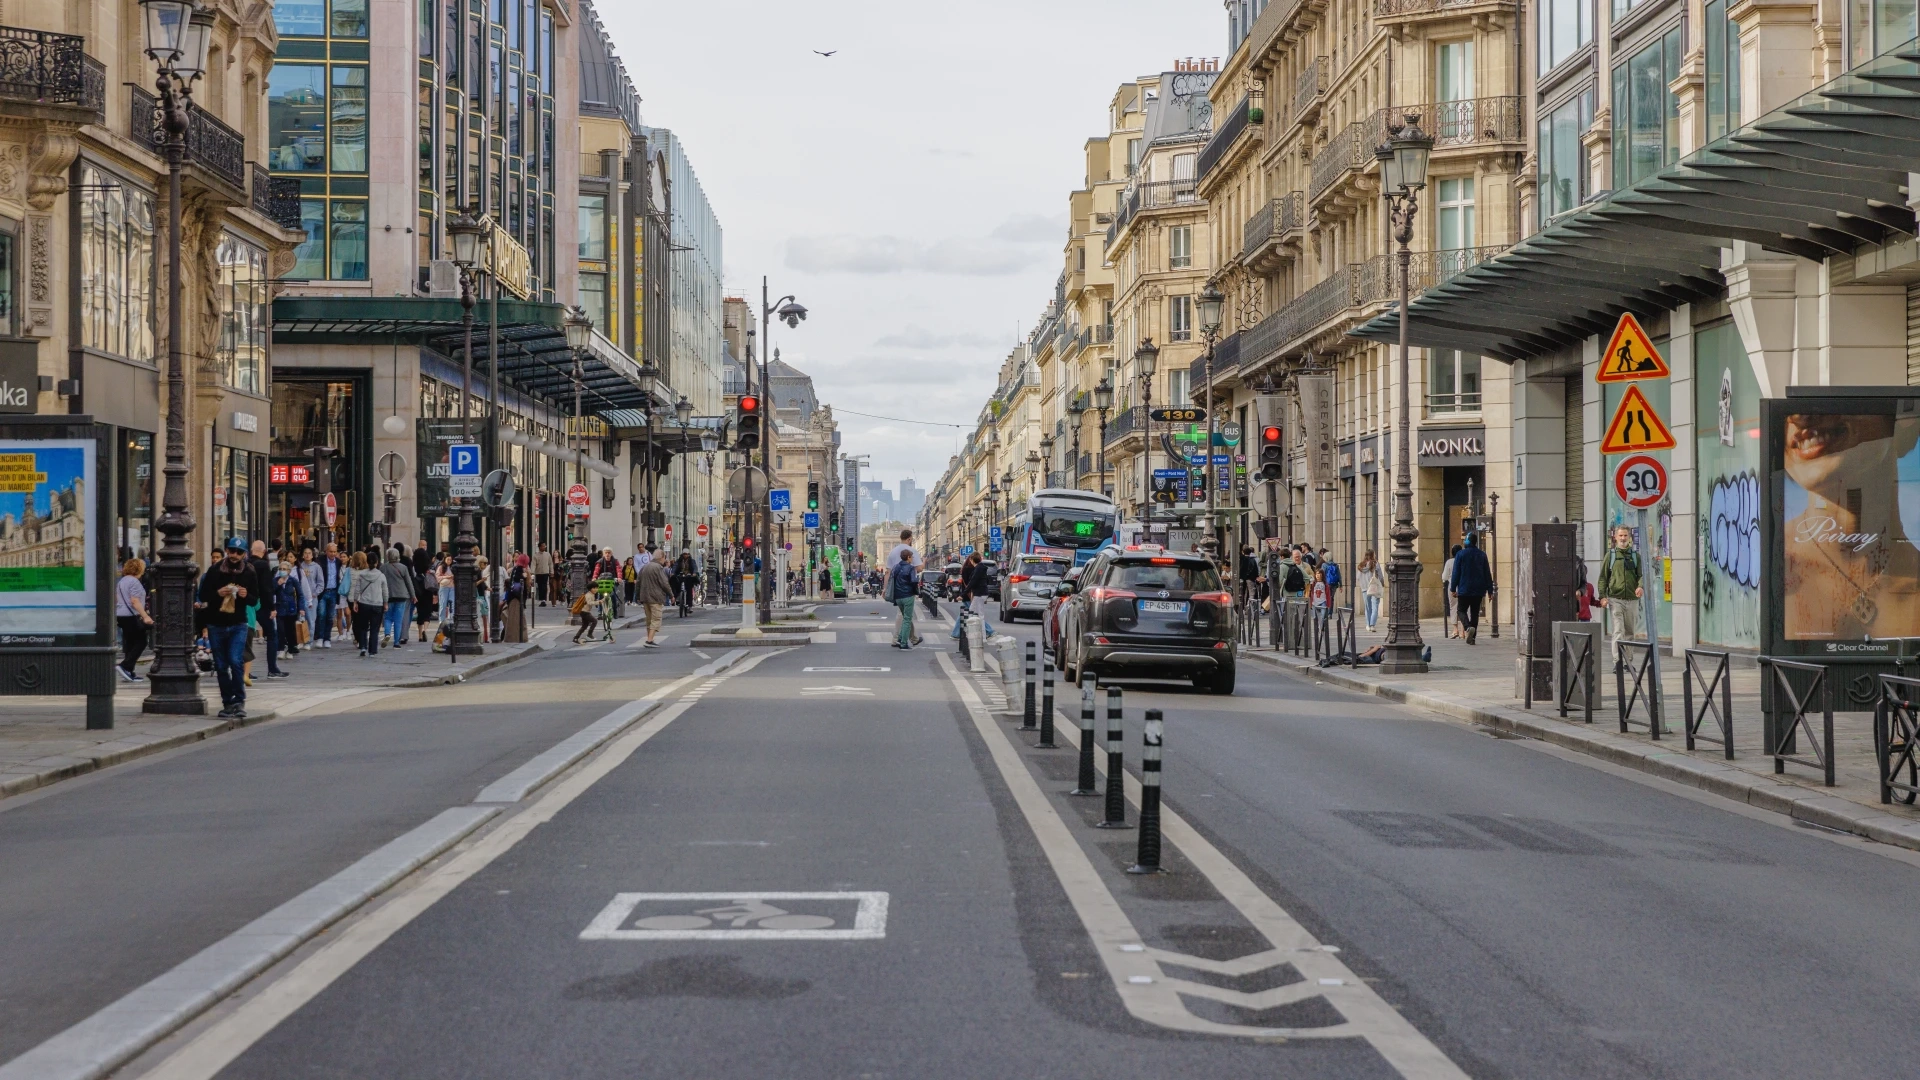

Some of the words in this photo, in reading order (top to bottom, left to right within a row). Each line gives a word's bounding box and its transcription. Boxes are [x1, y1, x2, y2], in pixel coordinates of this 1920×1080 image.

[1224, 427, 1239, 436] BUS
[1183, 445, 1196, 453] BUS
[1418, 437, 1483, 455] MONKI
[0, 455, 34, 463] NCONTRER
[458, 451, 472, 470] P
[28, 473, 45, 481] BILAN
[1626, 470, 1658, 492] 30
[1169, 532, 1204, 540] RIMO
[1794, 516, 1879, 552] Poiray
[1837, 644, 1858, 652] Clear
[1858, 644, 1889, 652] Channel
